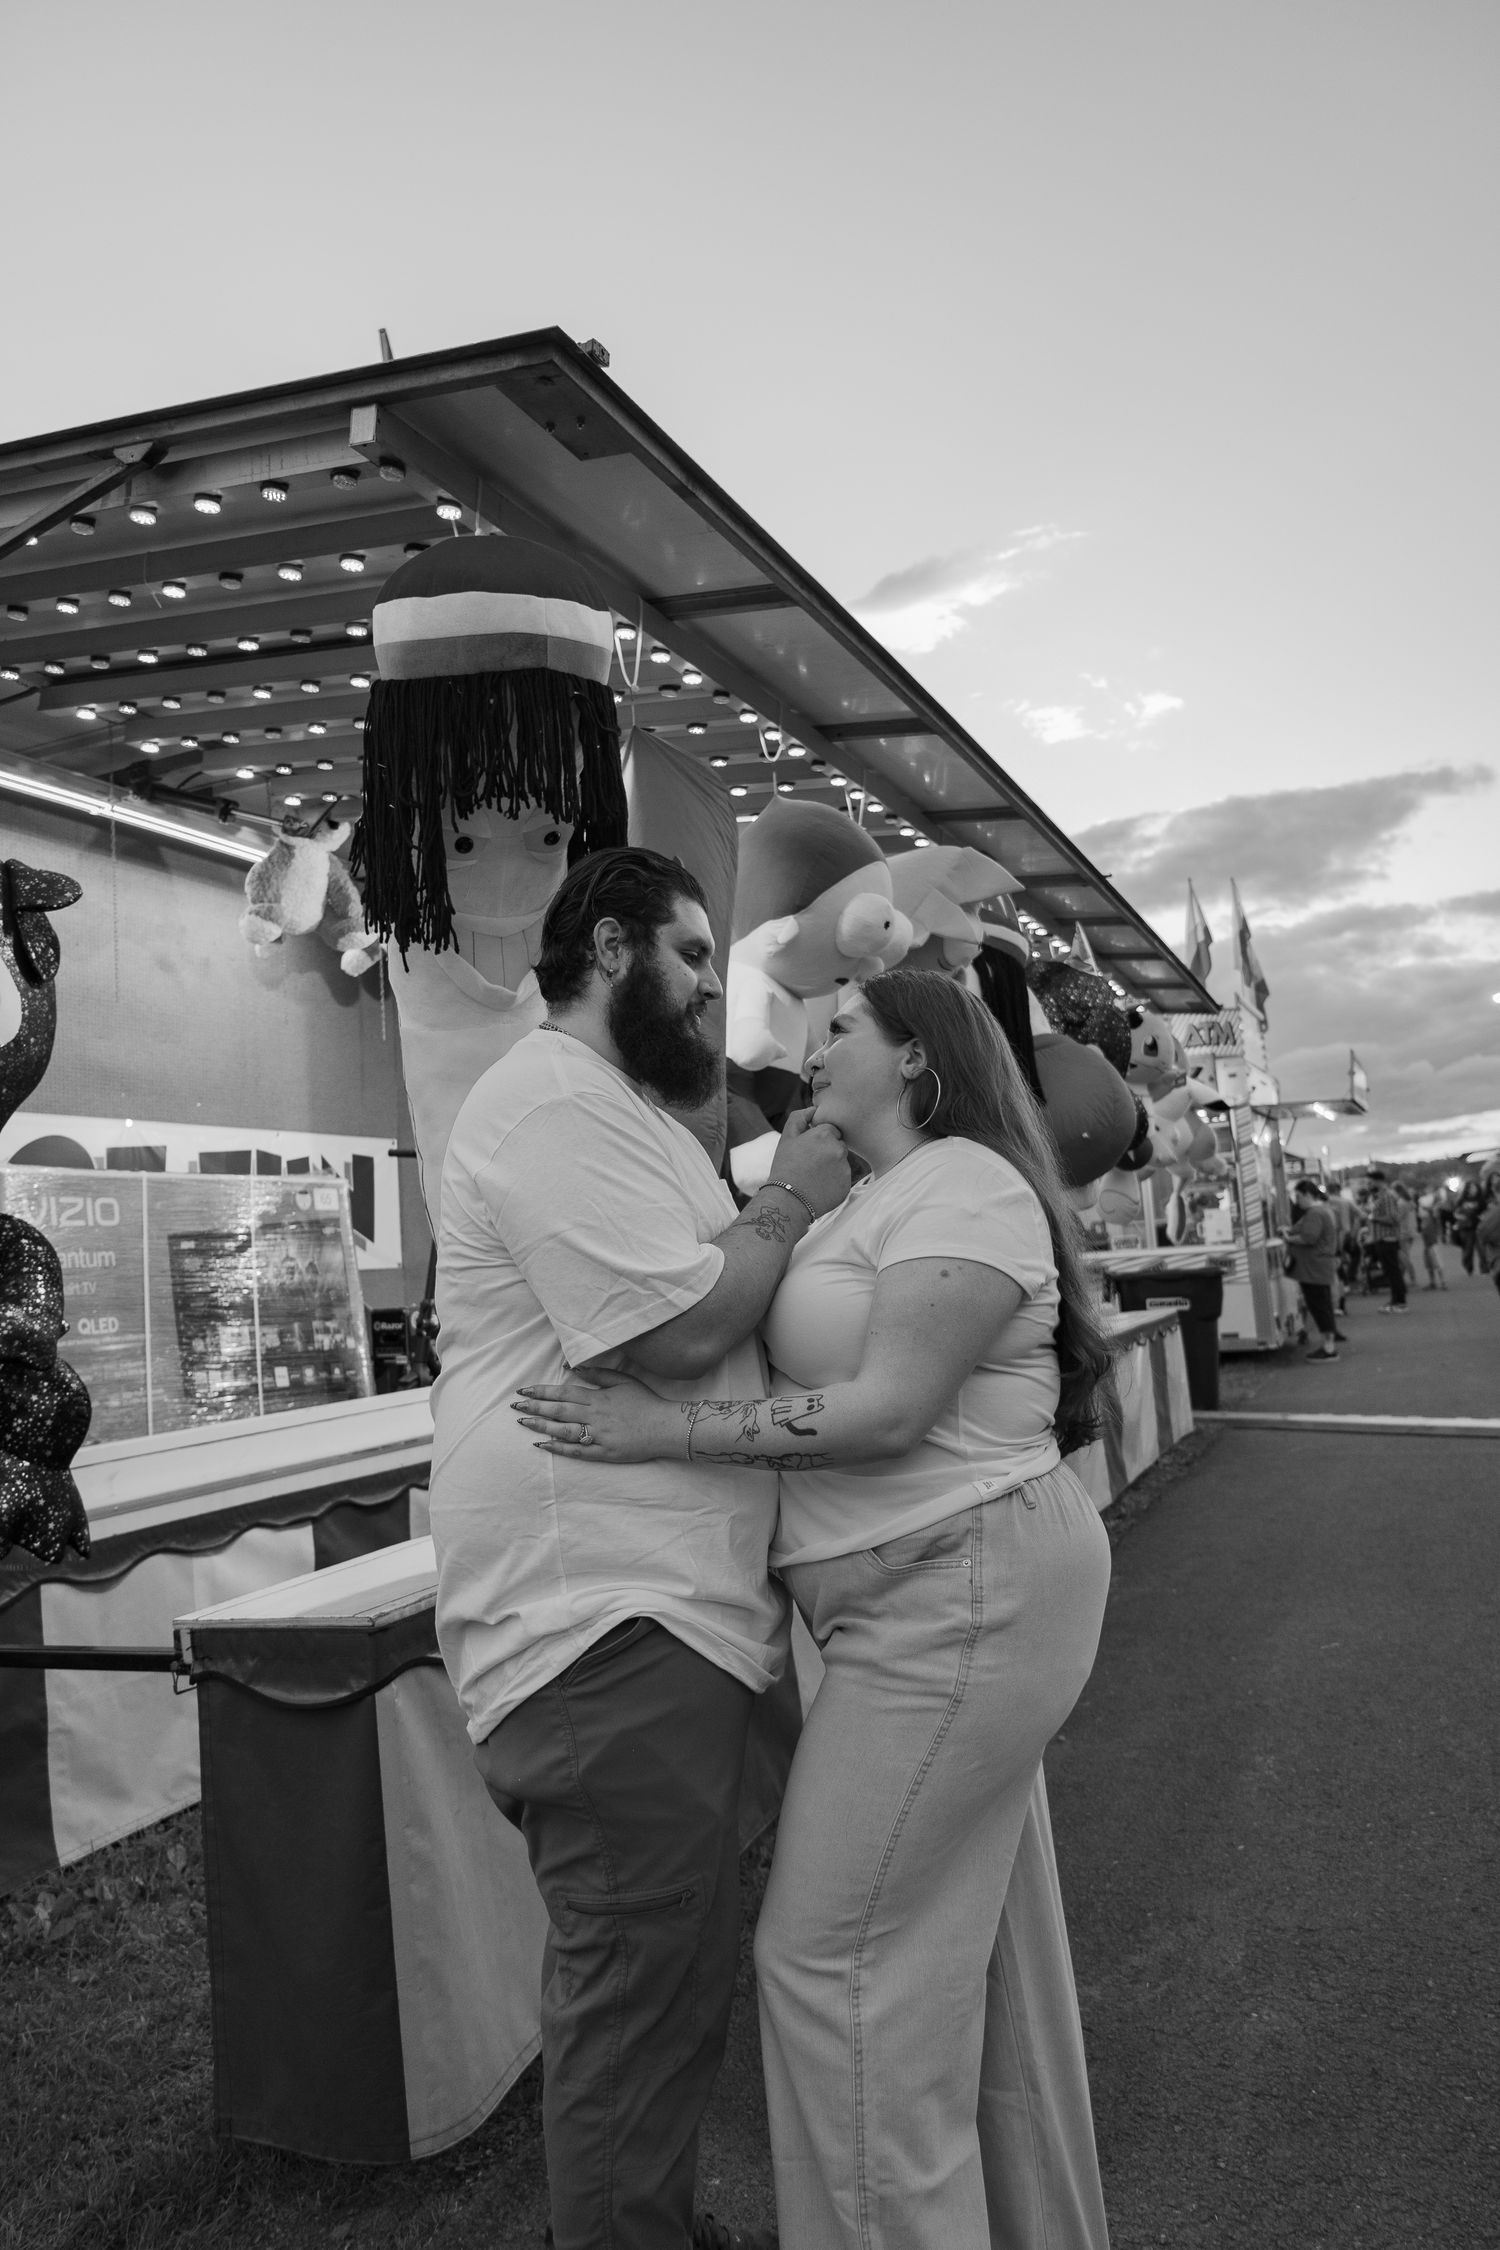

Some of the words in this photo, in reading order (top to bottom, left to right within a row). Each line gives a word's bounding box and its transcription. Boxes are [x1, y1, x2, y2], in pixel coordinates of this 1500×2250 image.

[1184, 1021, 1237, 1047] ATM
[32, 1196, 120, 1227] VIZIO
[57, 1248, 116, 1269] antum
[77, 1316, 119, 1335] QLED
